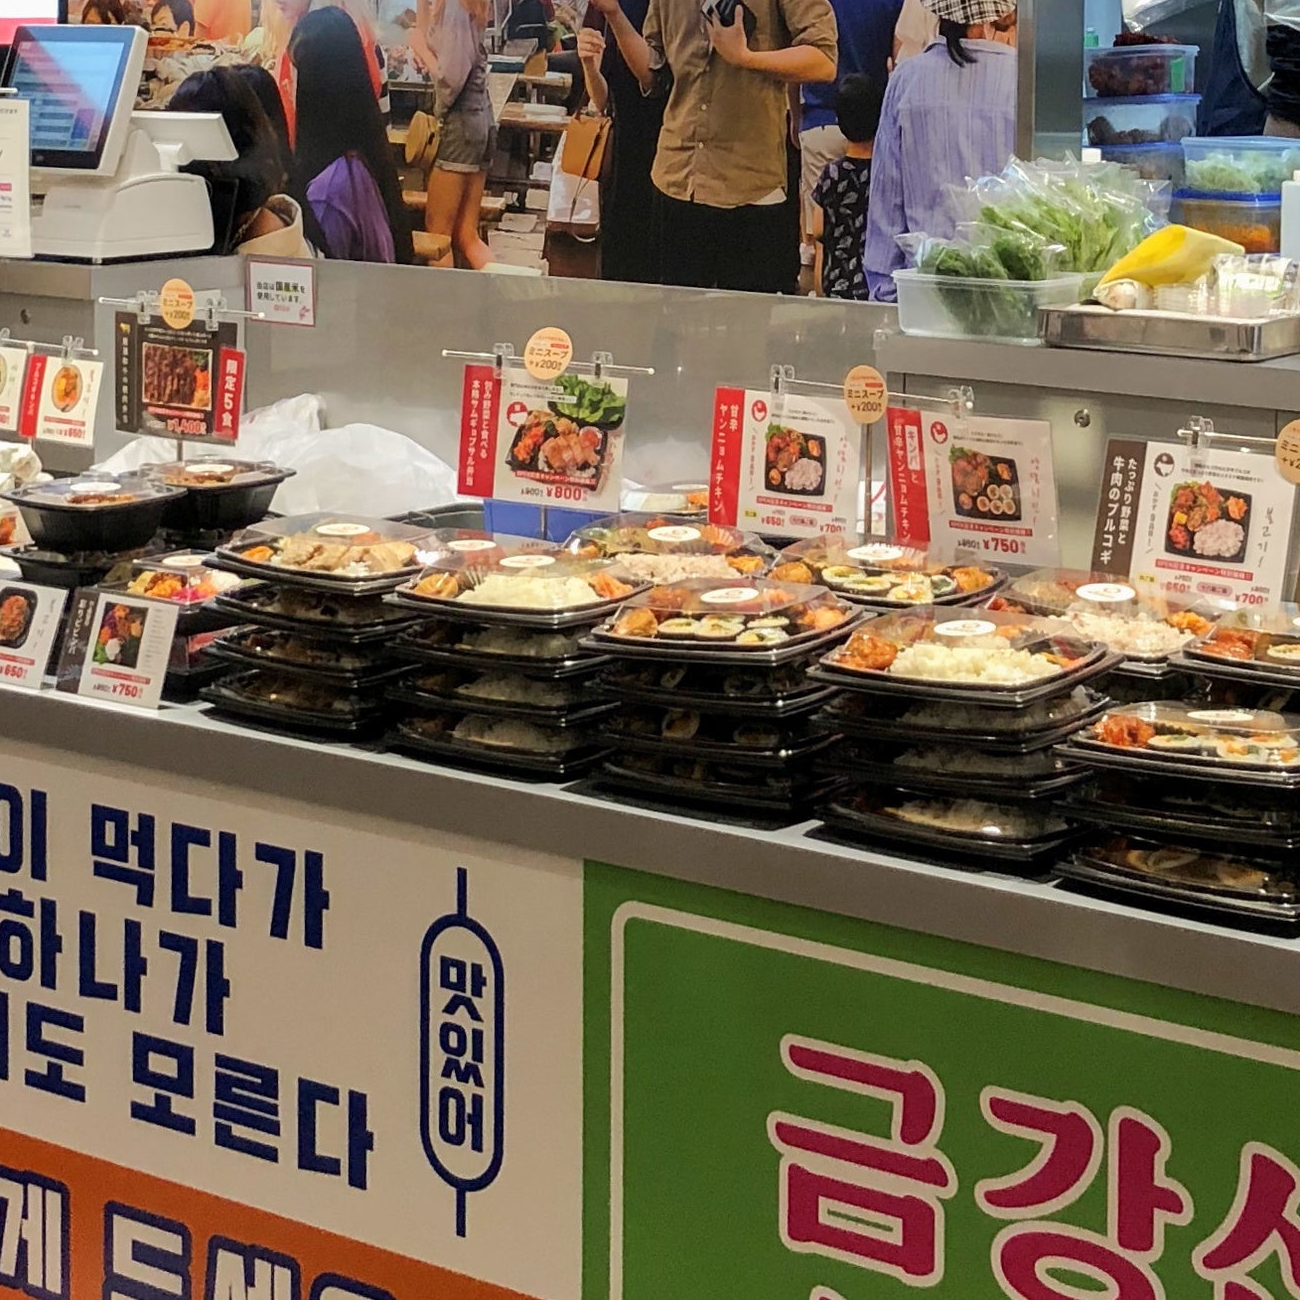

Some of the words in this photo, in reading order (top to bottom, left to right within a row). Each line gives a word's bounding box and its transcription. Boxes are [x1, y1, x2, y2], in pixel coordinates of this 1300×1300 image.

[529, 348, 569, 359] ミニスープ
[847, 389, 884, 400] ミニスープ
[714, 404, 728, 512] ヤンニョムチキン
[729, 405, 739, 431] 甘辛
[1117, 458, 1138, 545] たっぷり野菜と
[983, 537, 1019, 554] ¥750
[91, 803, 331, 950] 먹다가
[438, 954, 488, 1156] 맛있어
[131, 1031, 375, 1191] 모른다
